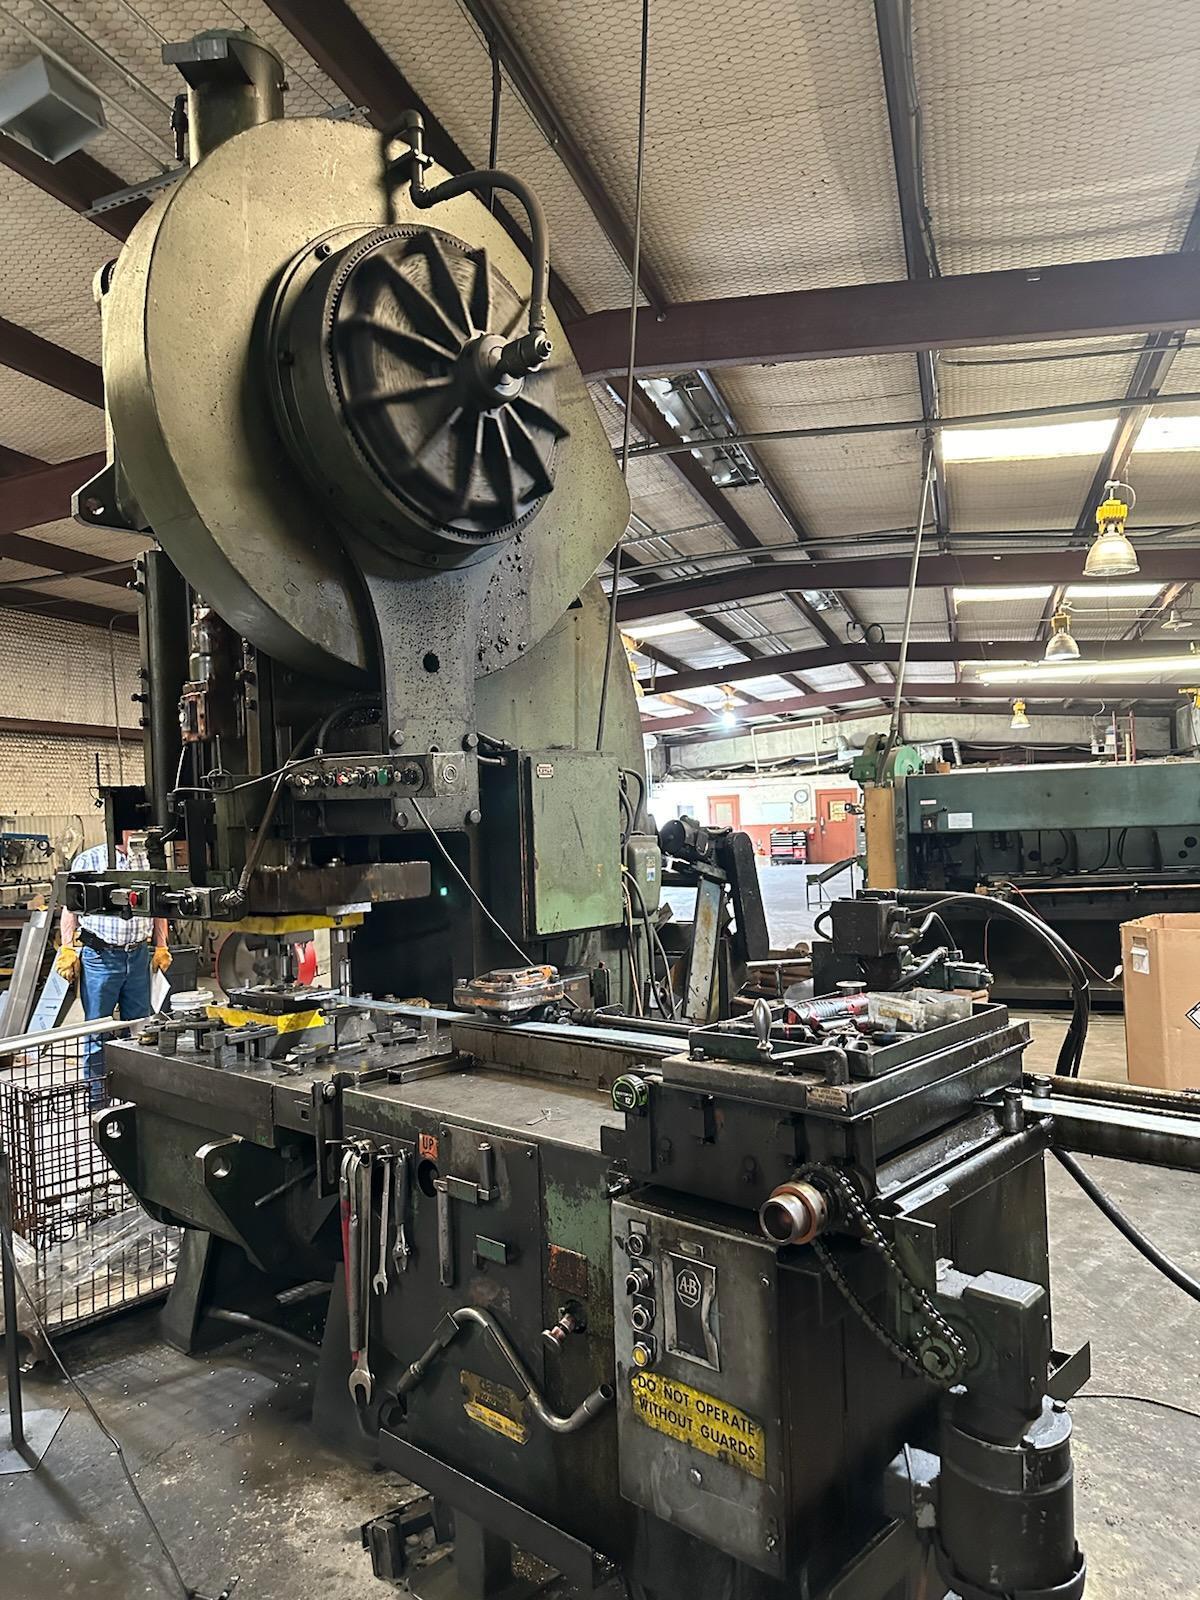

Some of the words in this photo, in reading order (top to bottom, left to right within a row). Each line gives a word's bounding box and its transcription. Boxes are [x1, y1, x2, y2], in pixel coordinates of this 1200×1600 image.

[422, 1136, 434, 1150] UP
[638, 1375, 656, 1392] DO
[664, 1385, 689, 1407] NOT
[696, 1400, 754, 1436] OPERATE
[640, 1396, 693, 1432] WITHOUT
[701, 1425, 755, 1460] GUARDS
